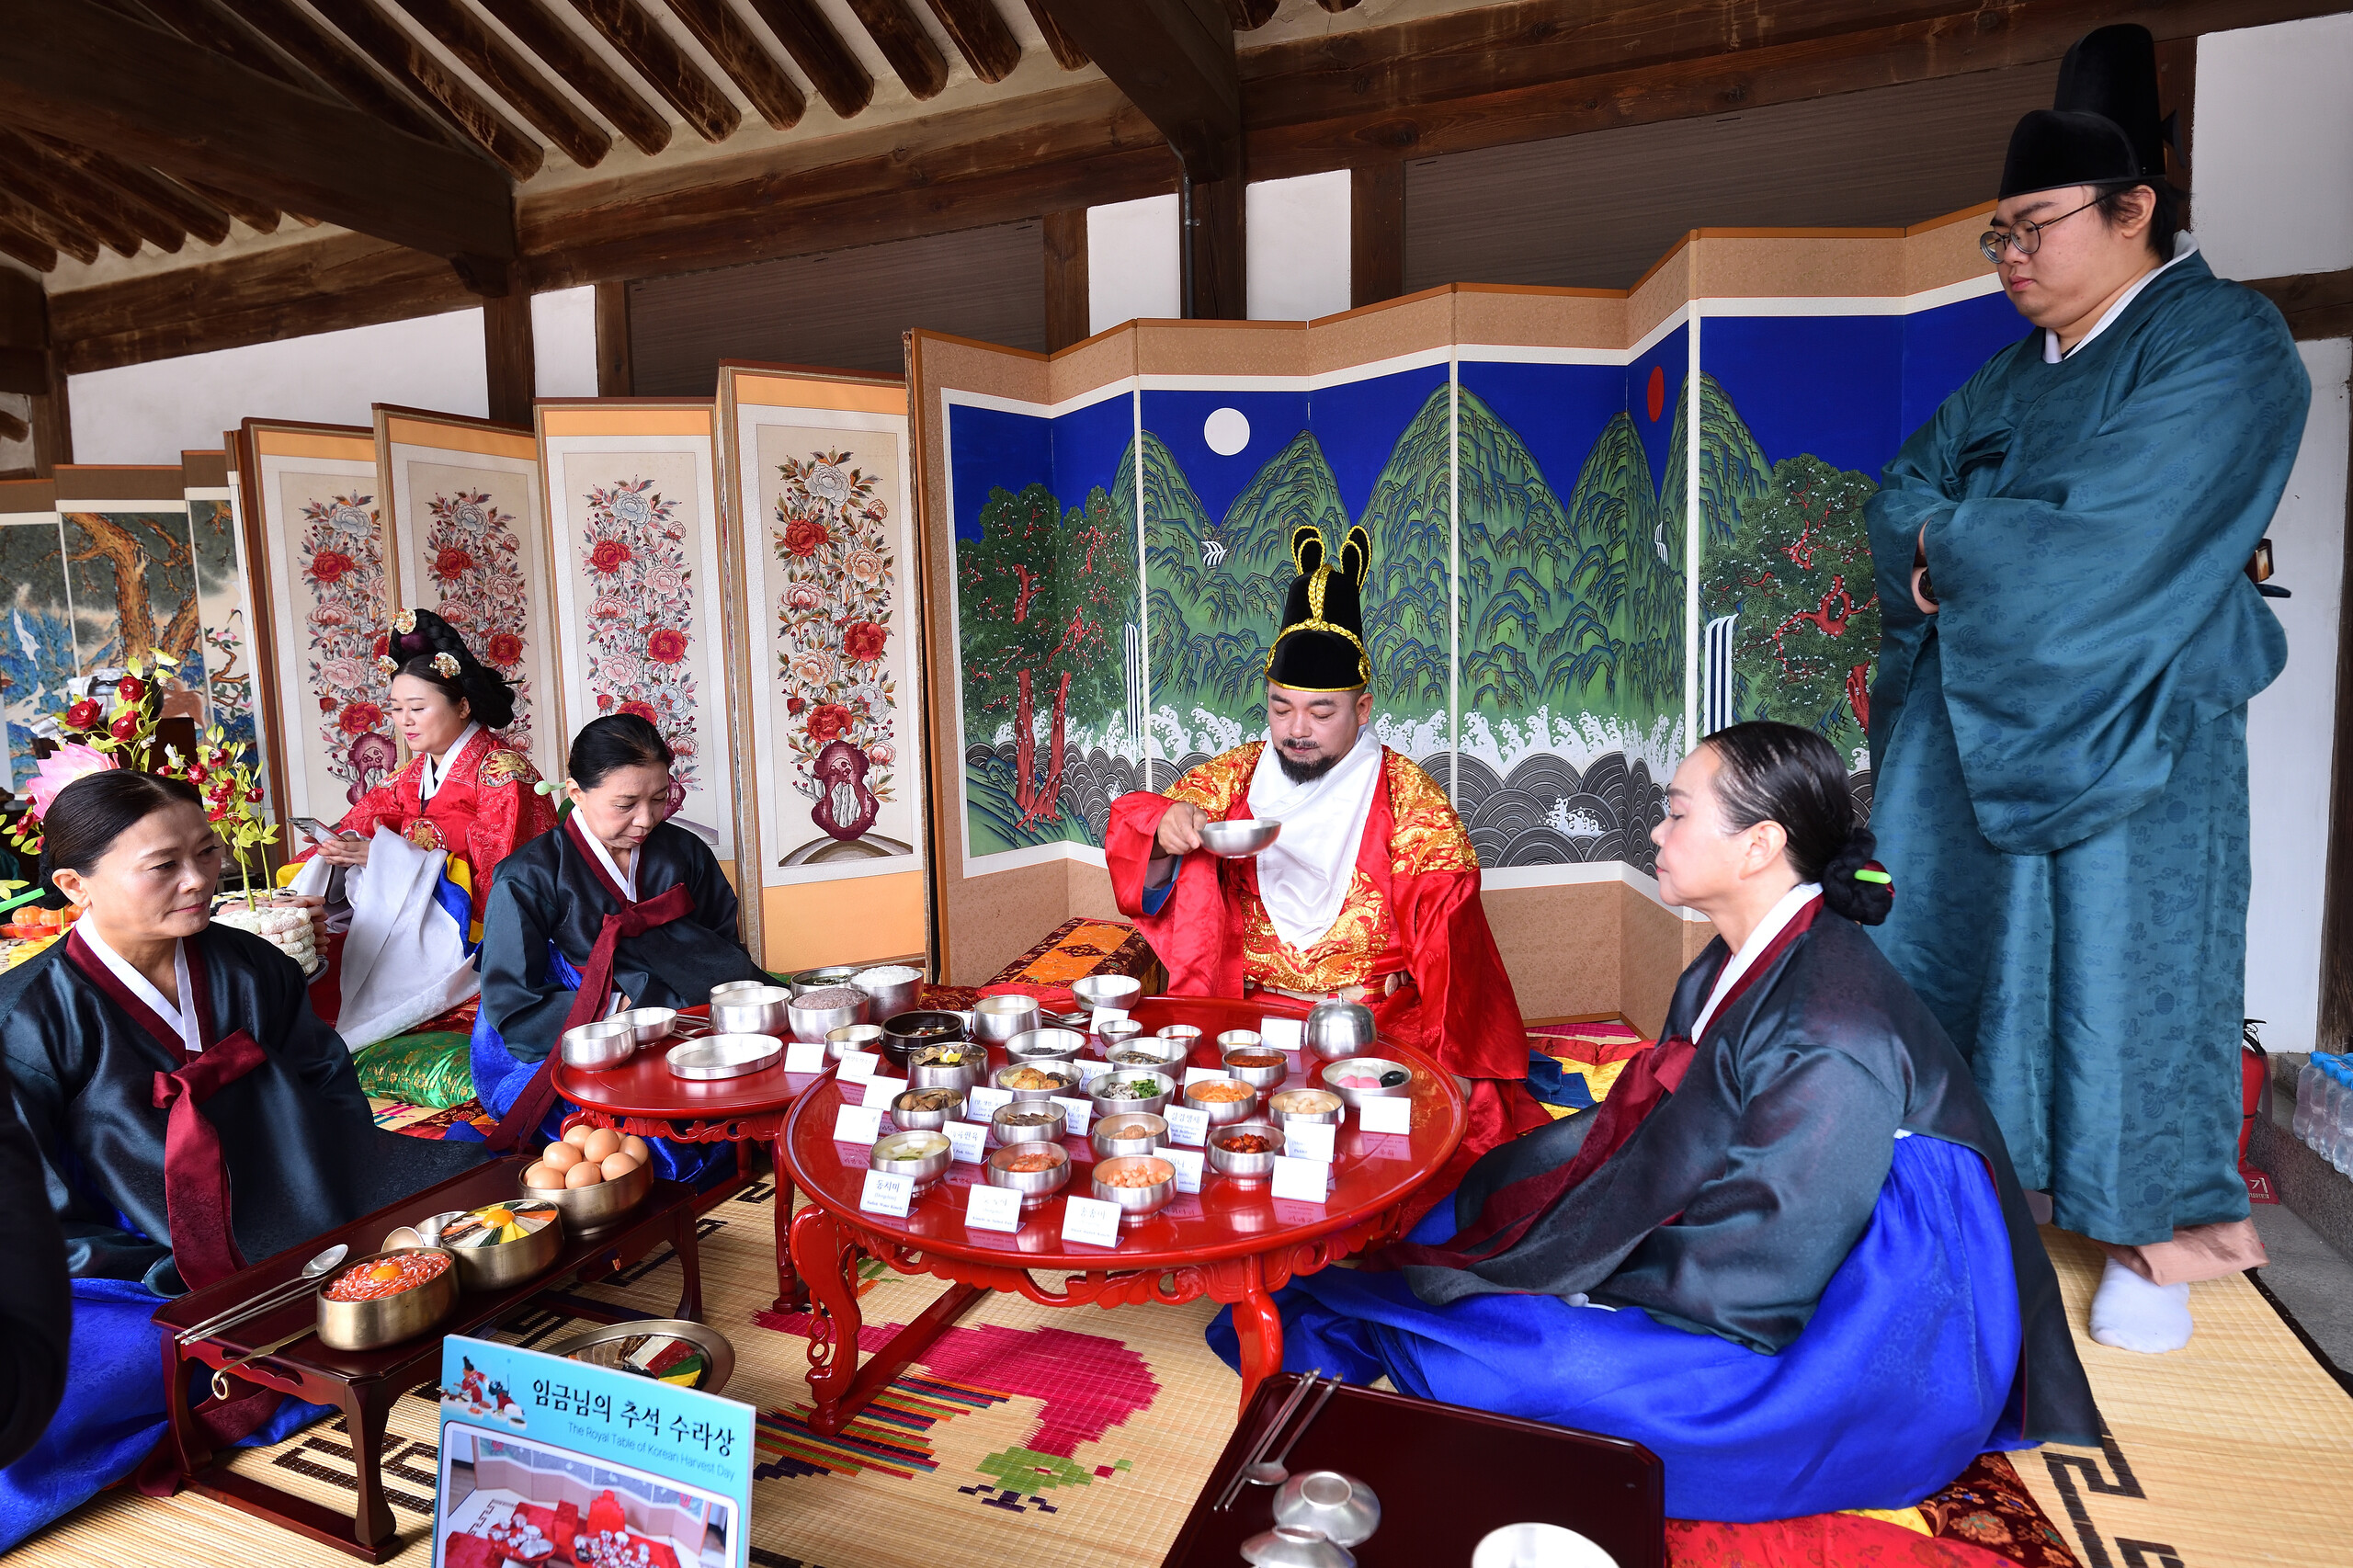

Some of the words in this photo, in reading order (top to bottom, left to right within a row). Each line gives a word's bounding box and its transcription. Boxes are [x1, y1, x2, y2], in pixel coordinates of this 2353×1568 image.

[876, 1179, 900, 1193] 동치미
[533, 1380, 610, 1423] 임금님의
[620, 1401, 659, 1437] 추석
[669, 1415, 735, 1457] 수라상
[568, 1421, 585, 1437] The
[586, 1426, 609, 1443] Royal
[611, 1433, 635, 1450] Table
[637, 1440, 646, 1452] of
[647, 1444, 678, 1463] Korean
[680, 1453, 714, 1472] Harvest
[717, 1463, 735, 1483] Day
